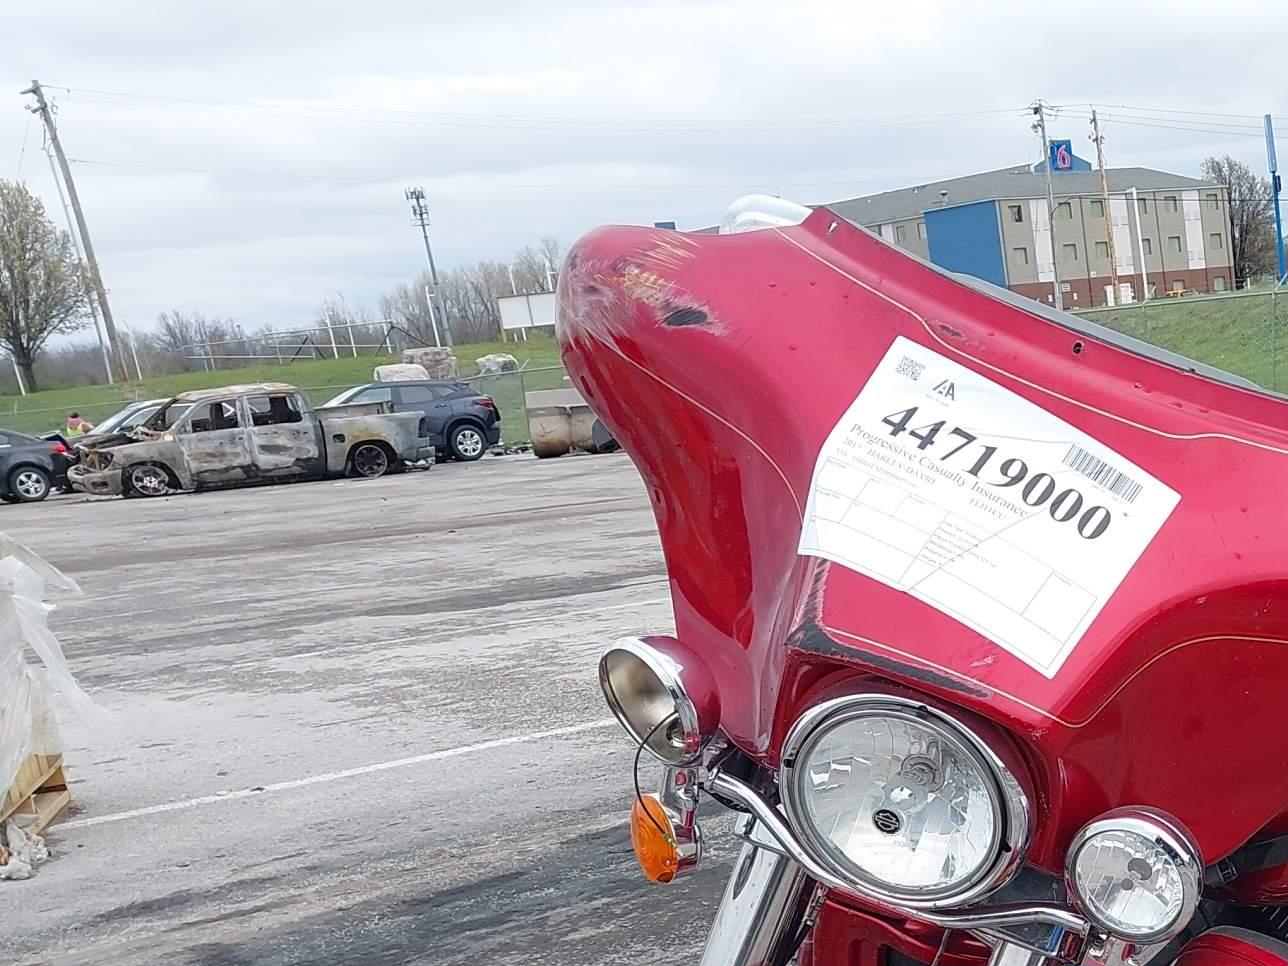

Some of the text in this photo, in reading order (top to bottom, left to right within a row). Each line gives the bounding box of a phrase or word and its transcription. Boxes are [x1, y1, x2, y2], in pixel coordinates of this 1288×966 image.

[1057, 144, 1071, 169] 6
[849, 423, 918, 462] Progressive
[918, 456, 967, 487] Casualty
[970, 481, 1029, 518] Insurance
[881, 406, 1112, 539] 44719000
